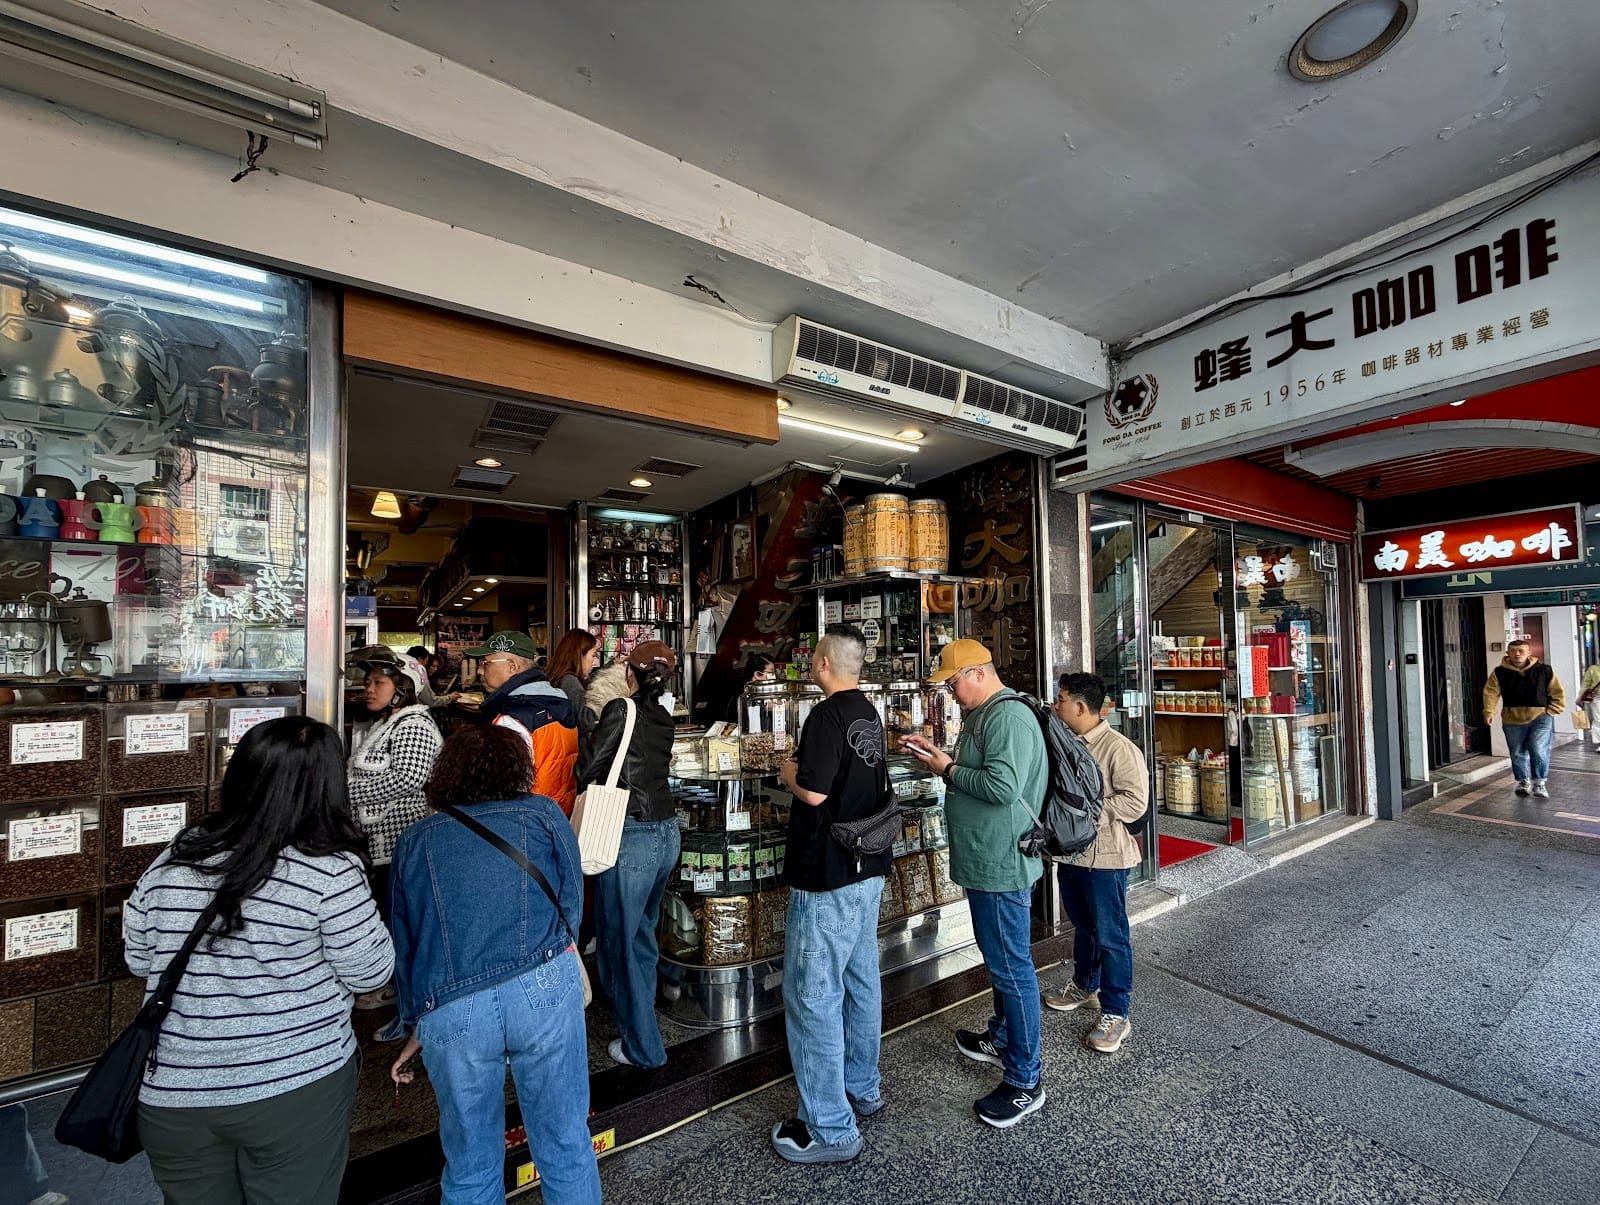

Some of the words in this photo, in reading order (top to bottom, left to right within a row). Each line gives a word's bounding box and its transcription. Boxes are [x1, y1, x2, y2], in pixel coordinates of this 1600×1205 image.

[1193, 218, 1559, 393] 蜂大咖啡
[1361, 307, 1551, 378] 咖啡器材專業經營
[1102, 434, 1121, 445] FONG
[1122, 431, 1133, 439] DA
[1134, 421, 1163, 435] COFFEE
[1373, 521, 1573, 573] 南美咖啡
